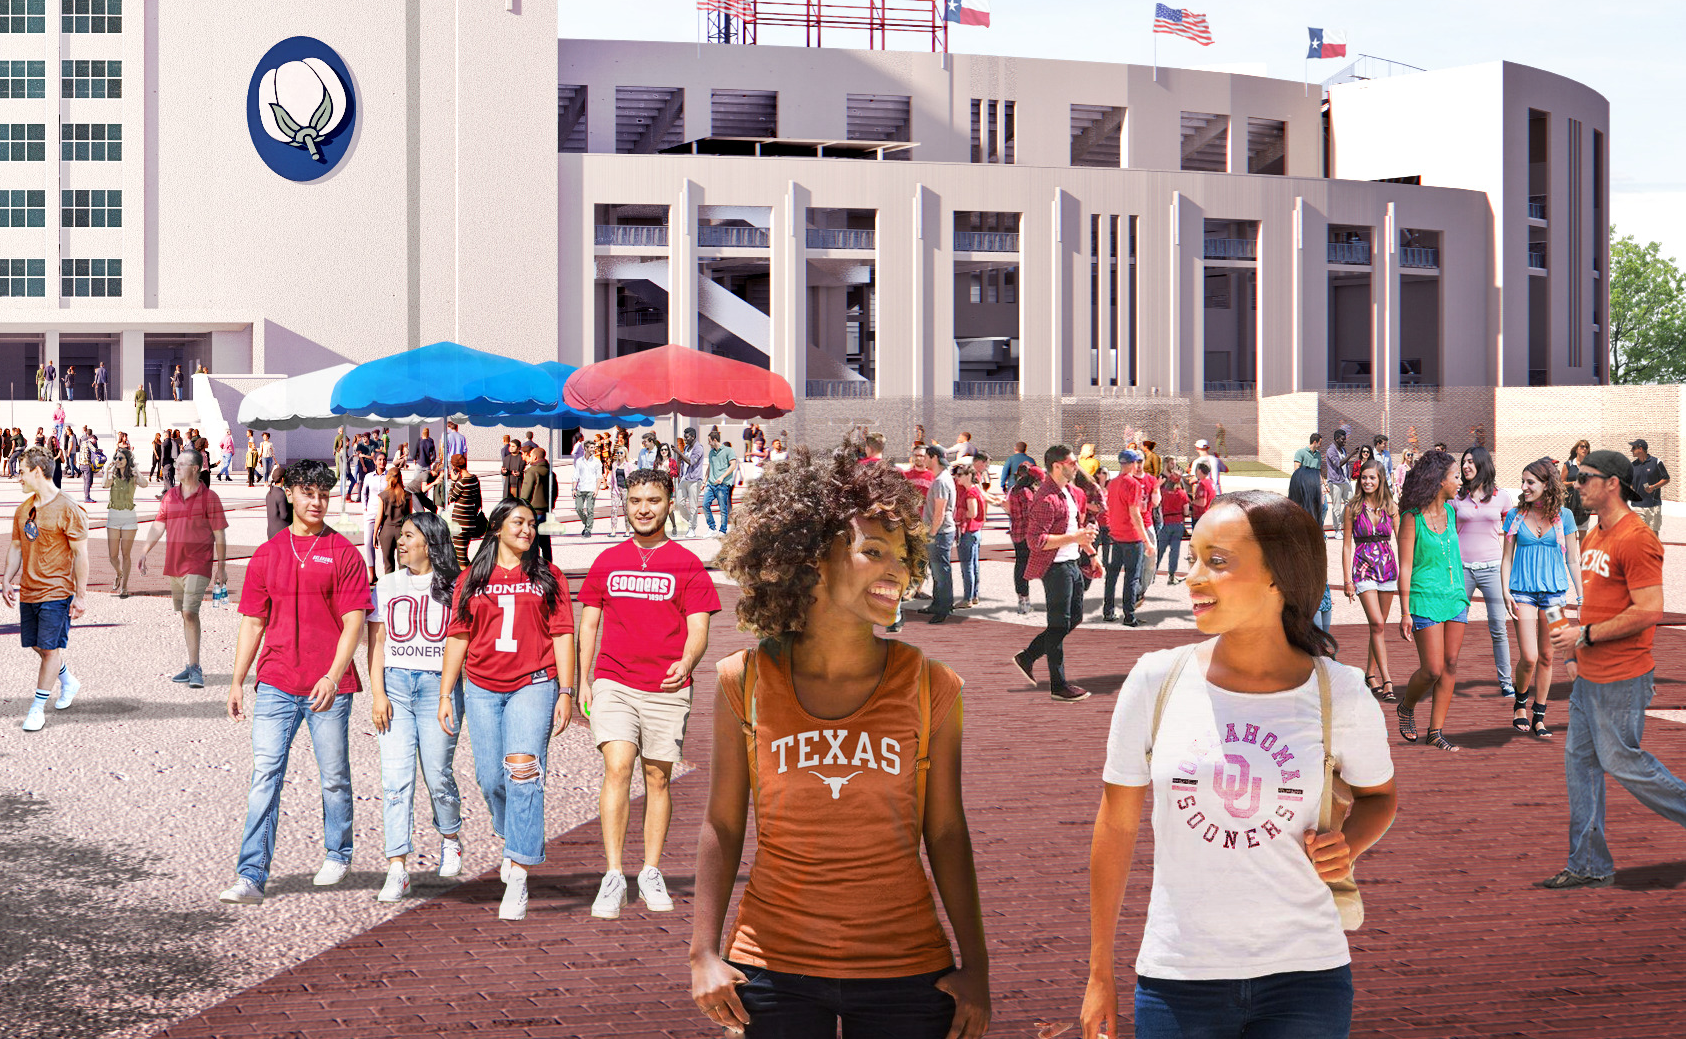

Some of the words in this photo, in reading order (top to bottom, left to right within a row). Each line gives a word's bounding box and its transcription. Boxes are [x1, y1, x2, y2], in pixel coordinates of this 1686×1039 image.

[387, 595, 451, 643] OU
[495, 595, 517, 653] 1
[771, 729, 901, 775] TEXAS
[1178, 723, 1301, 784] OAHOMA
